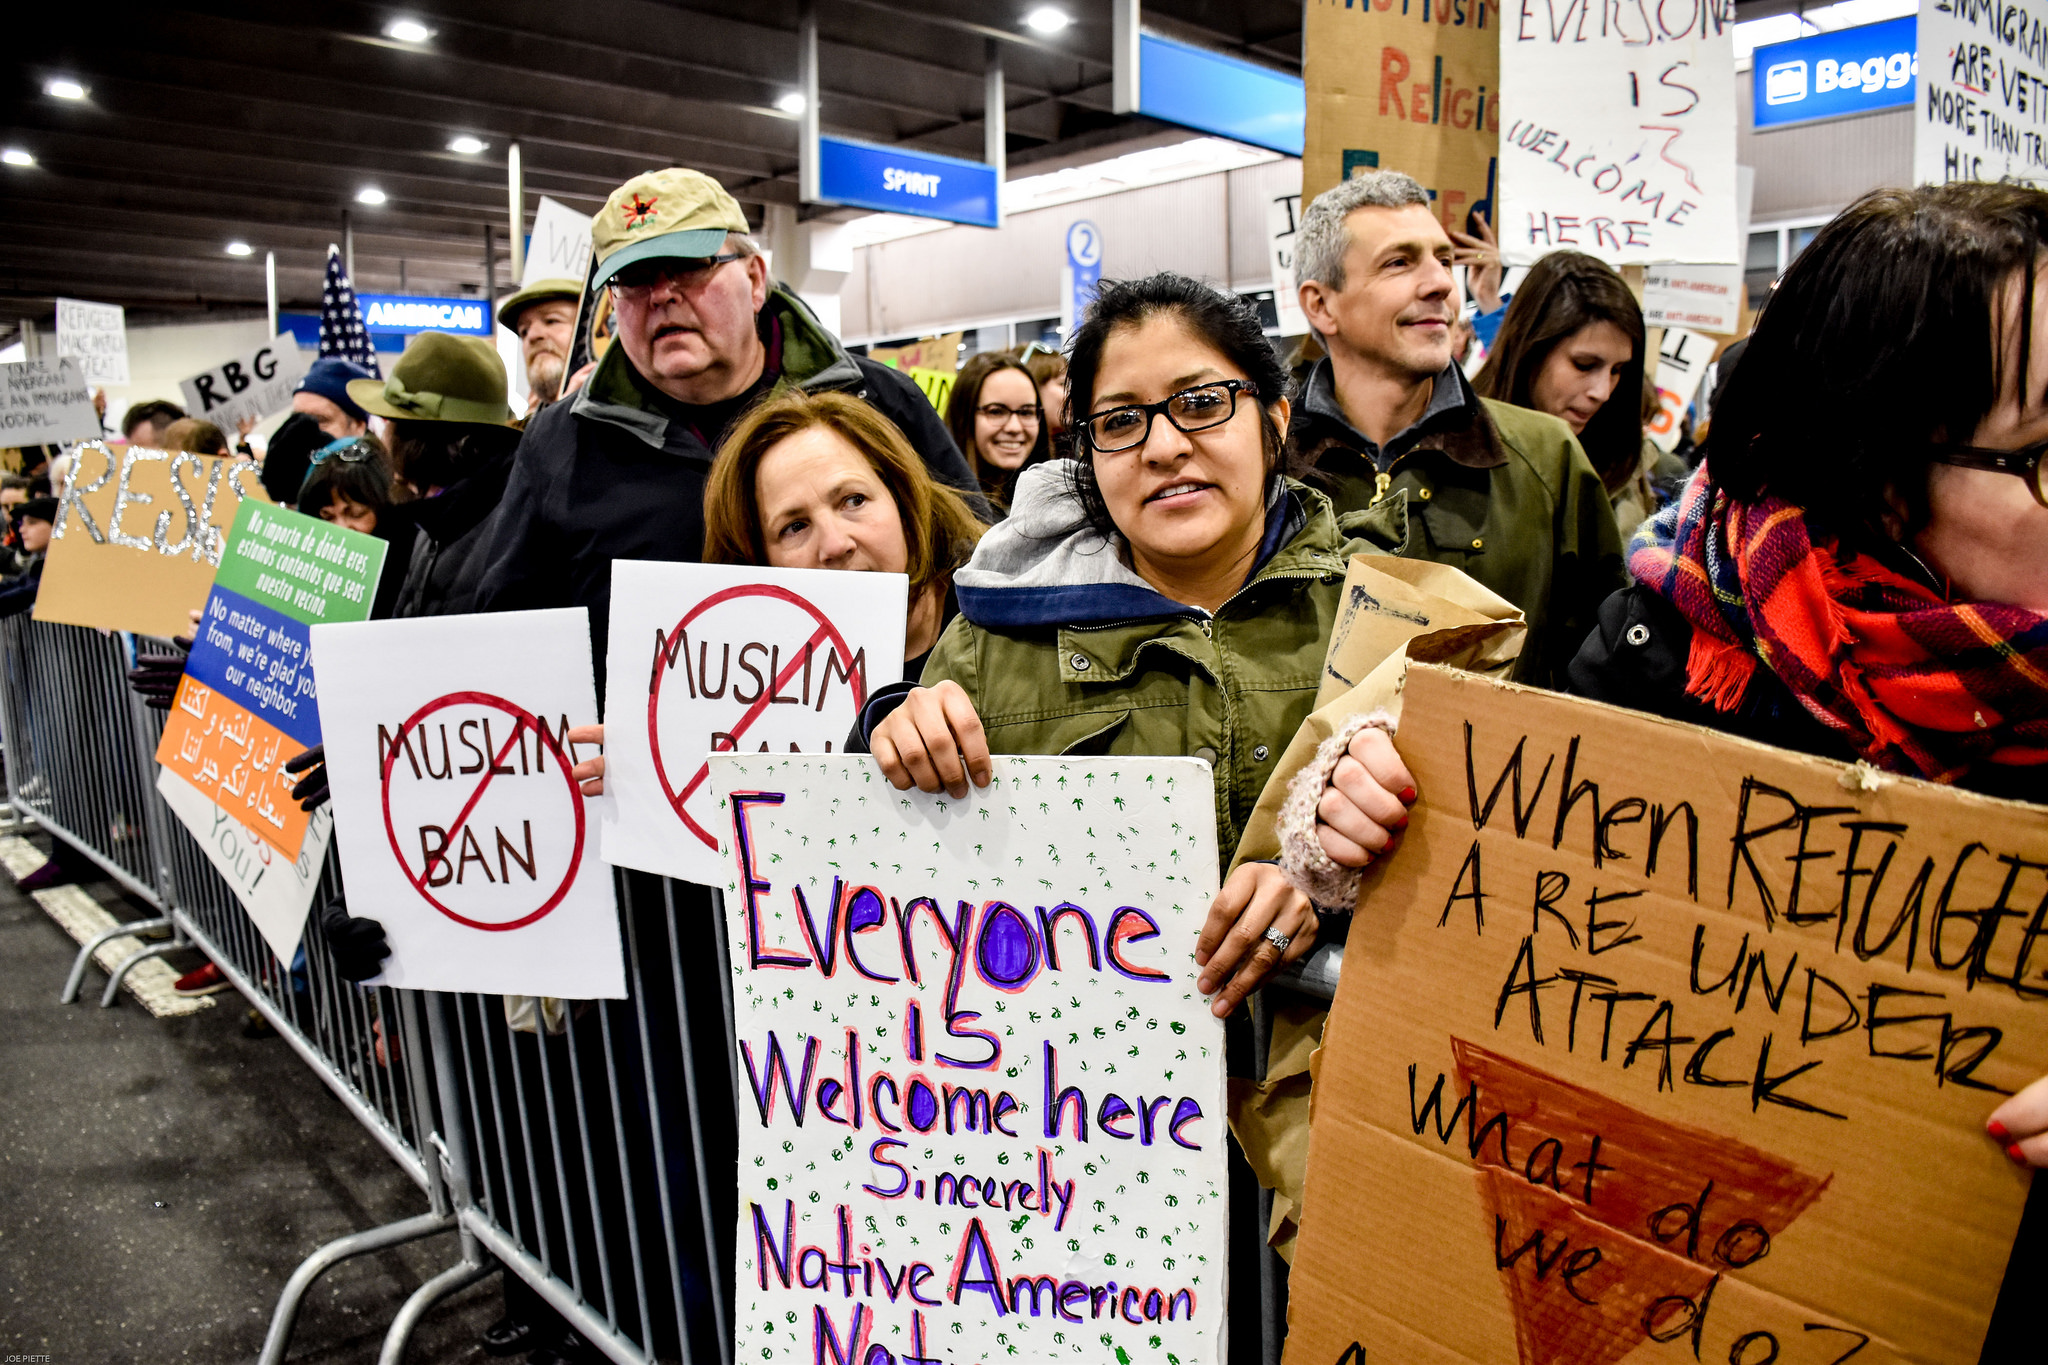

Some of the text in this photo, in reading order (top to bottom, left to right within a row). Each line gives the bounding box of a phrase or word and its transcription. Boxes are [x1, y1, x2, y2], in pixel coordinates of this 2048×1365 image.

[1628, 61, 1698, 116] IS
[1928, 82, 1976, 136] MORE
[1980, 110, 2019, 156] THAN
[883, 167, 941, 198] SPIRIT
[1507, 119, 1697, 227] WELCOME
[1527, 211, 1652, 251] HERE
[367, 303, 482, 329] AMERICAN
[194, 347, 278, 413] RBG
[236, 538, 366, 604] estamos contentos que seas
[247, 510, 369, 580] No importa de dónde eres,
[208, 596, 228, 621] No
[228, 610, 267, 640] matter
[267, 625, 302, 659] where
[256, 572, 327, 618] nuestro vecino.
[206, 620, 234, 657] from,
[238, 643, 269, 671] we're
[264, 656, 298, 687] glad
[650, 628, 868, 712] MUSLIM
[225, 665, 298, 720] our neighbor.
[377, 714, 579, 781] MUSLIM
[246, 779, 286, 831] سعداء
[1464, 719, 1698, 902] When
[419, 819, 537, 888] BAN
[729, 790, 1172, 1021] Everyone
[1494, 934, 1848, 1120] ATTACK
[1690, 923, 2016, 1097] UNDER
[739, 1026, 1203, 1152] Welcome here
[862, 1136, 1076, 1232] Sincerely
[1408, 1063, 1771, 1268] What do
[751, 1198, 1198, 1324] Native American
[1494, 1213, 1604, 1306] we
